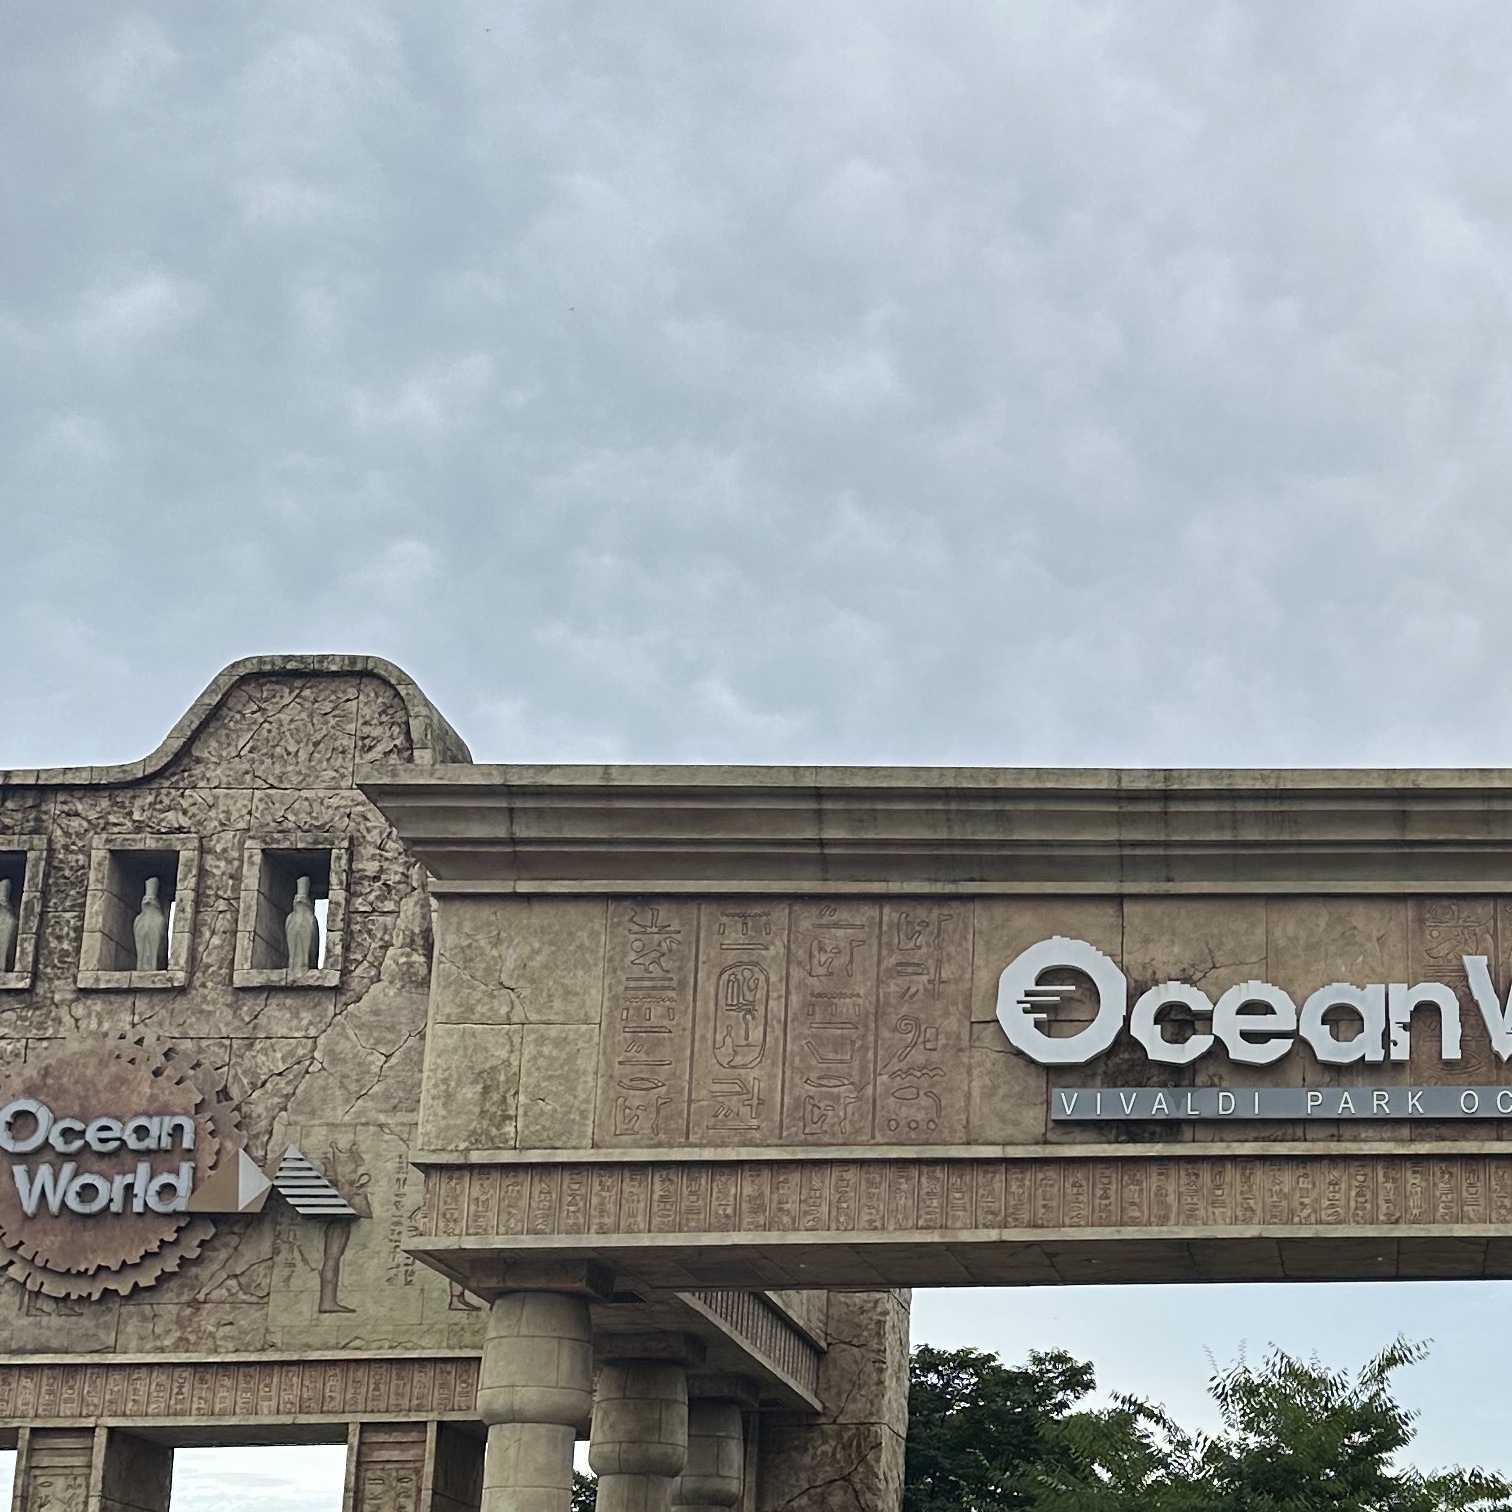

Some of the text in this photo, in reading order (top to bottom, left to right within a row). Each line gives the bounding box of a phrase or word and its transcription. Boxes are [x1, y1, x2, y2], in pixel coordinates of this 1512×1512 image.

[0, 1098, 196, 1154] Ocean
[1060, 1091, 1261, 1116] VIVALDI
[1306, 1090, 1427, 1115] PARK
[12, 1161, 196, 1218] World
